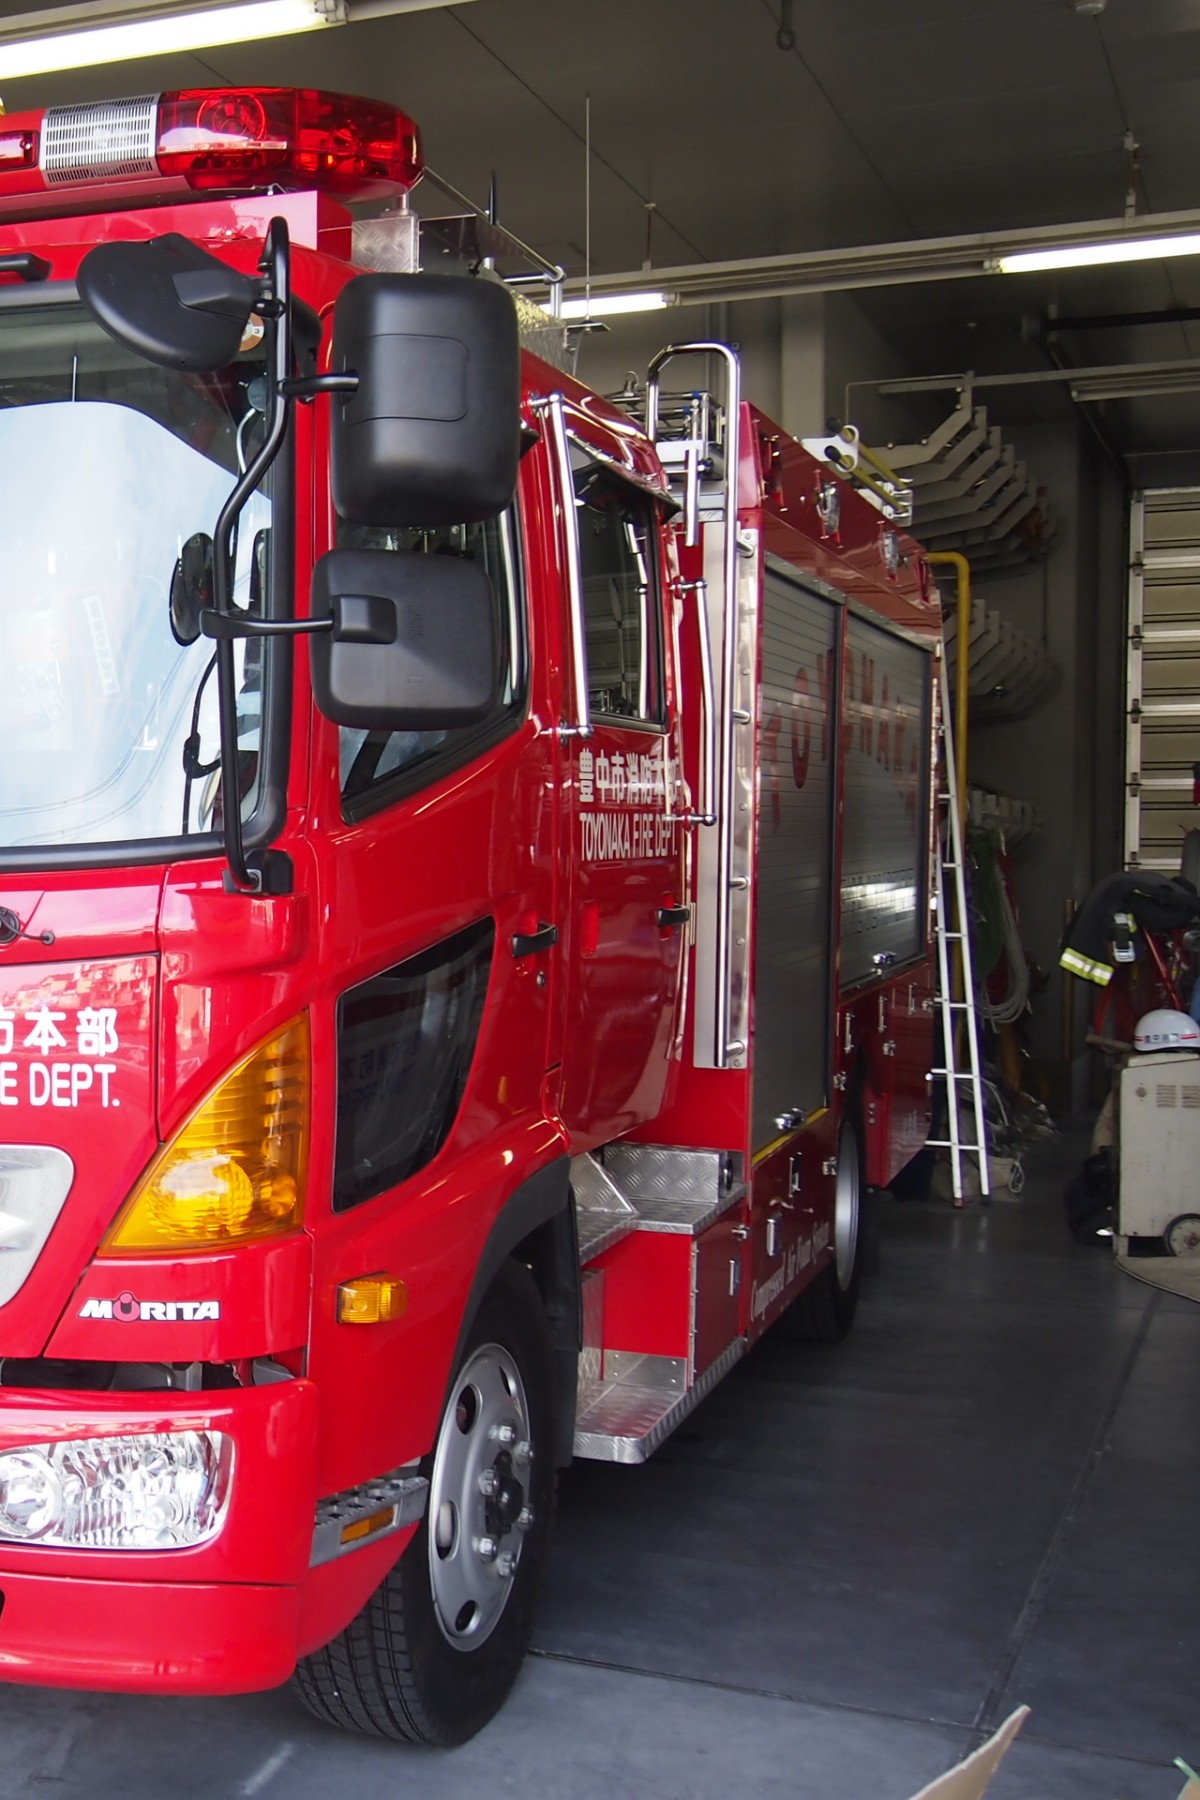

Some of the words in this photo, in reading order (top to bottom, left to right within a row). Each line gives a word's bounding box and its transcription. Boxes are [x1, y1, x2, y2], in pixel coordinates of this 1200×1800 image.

[579, 812, 631, 862] TOYONAKA
[632, 812, 654, 859] FIRE
[29, 1061, 121, 1108] DEPT.
[78, 1291, 220, 1323] MORITA
